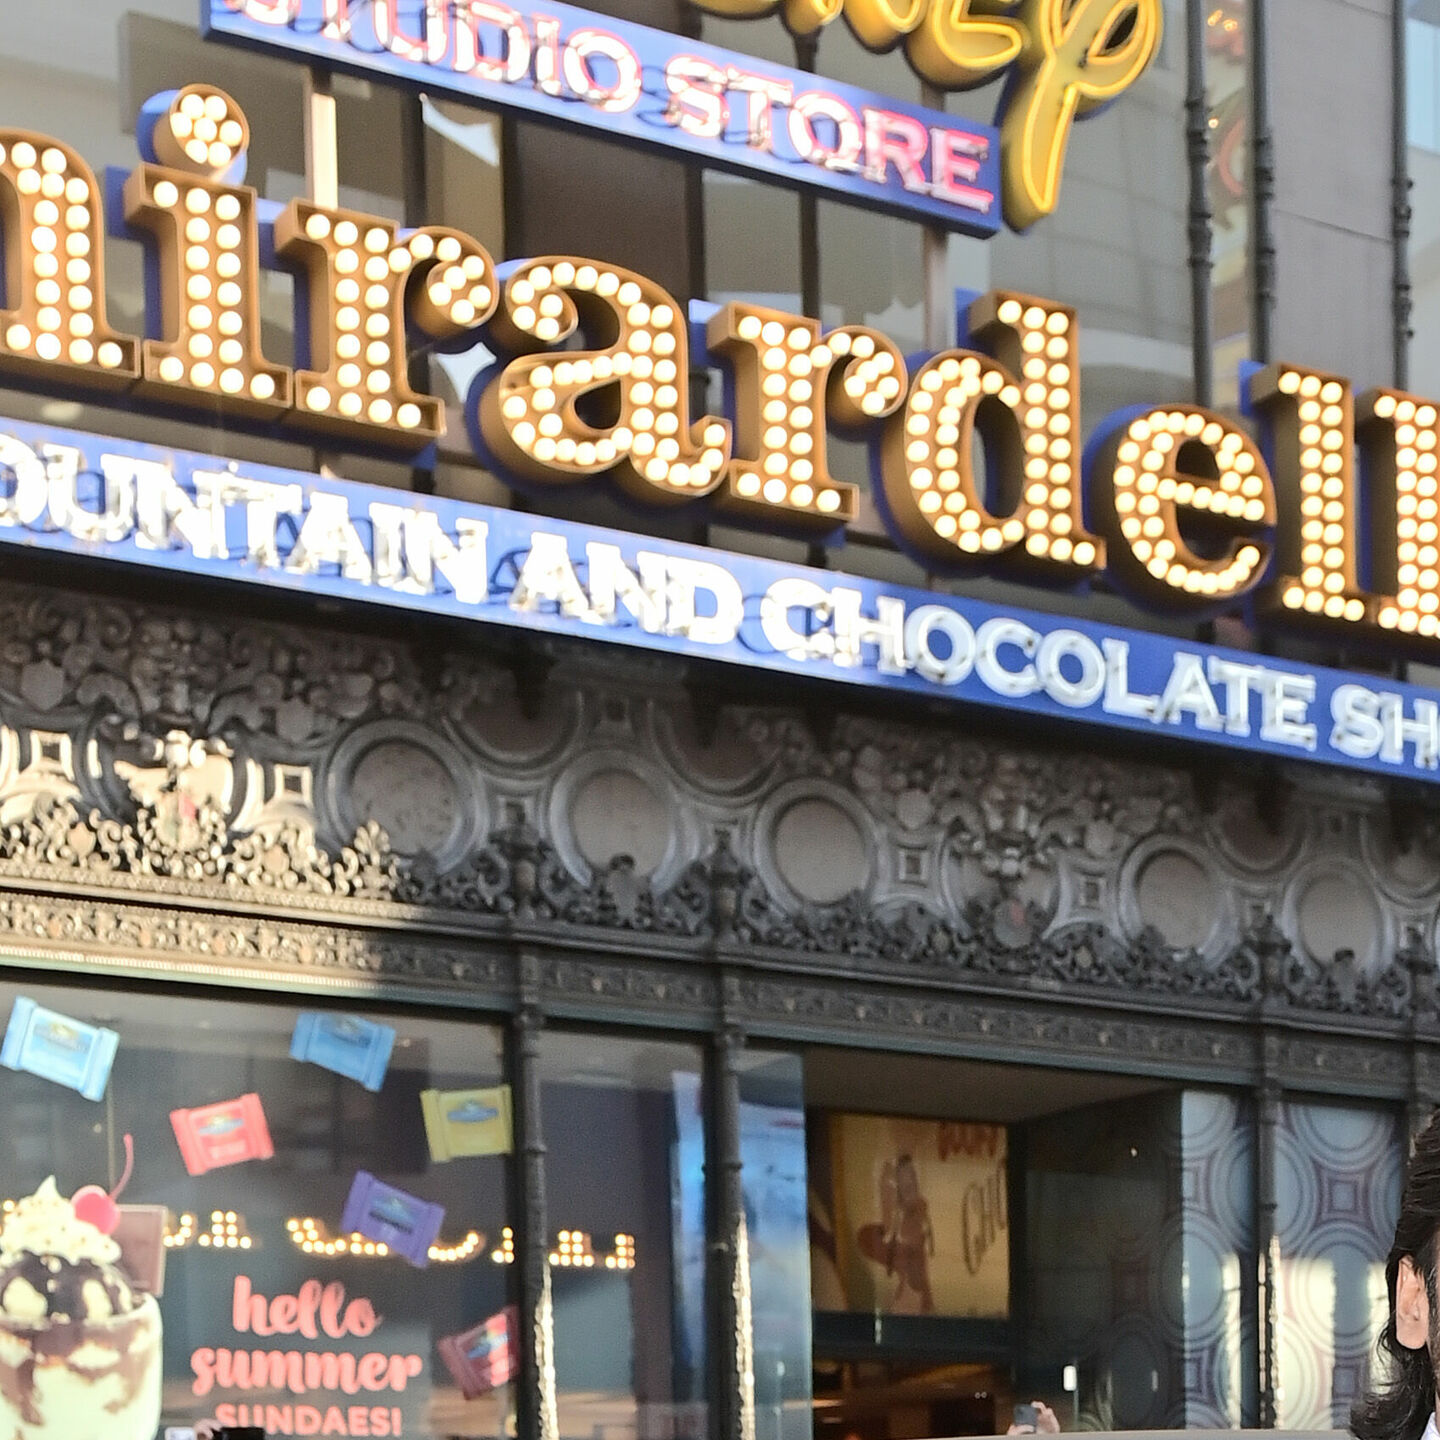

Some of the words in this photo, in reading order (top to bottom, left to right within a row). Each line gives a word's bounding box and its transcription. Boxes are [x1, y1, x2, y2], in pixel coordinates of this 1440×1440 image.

[665, 54, 995, 215] STORE
[510, 531, 745, 645] AND
[760, 578, 1318, 751] CHOCOLATE
[232, 1274, 384, 1340] hello
[190, 1346, 423, 1396] summer
[215, 1402, 402, 1437] SUNDAES!
